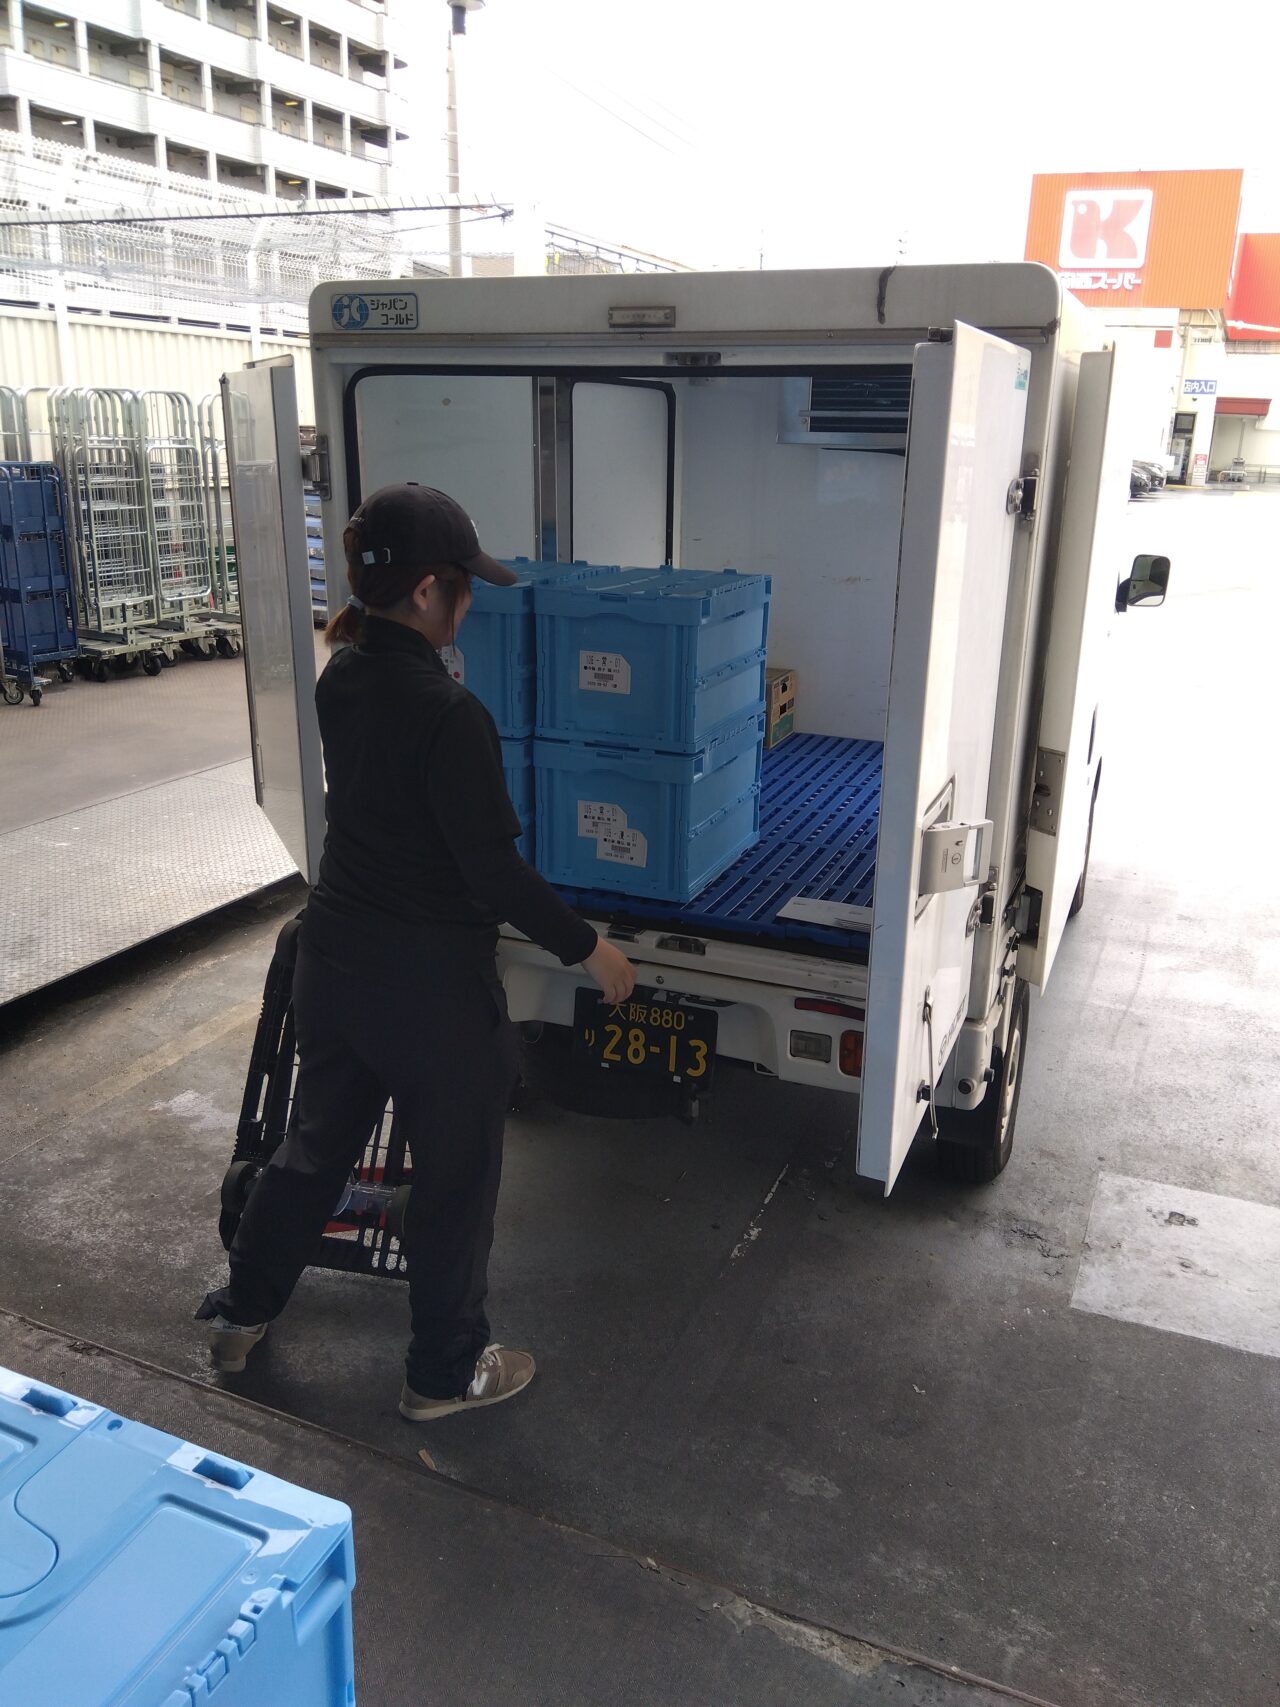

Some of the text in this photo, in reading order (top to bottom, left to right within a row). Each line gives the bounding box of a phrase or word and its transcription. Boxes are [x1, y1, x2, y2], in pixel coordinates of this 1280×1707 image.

[370, 297, 408, 311] ジャパン
[380, 313, 414, 326] コールド
[1184, 380, 1217, 393] 店内入口
[584, 1024, 708, 1077] り 28-13
